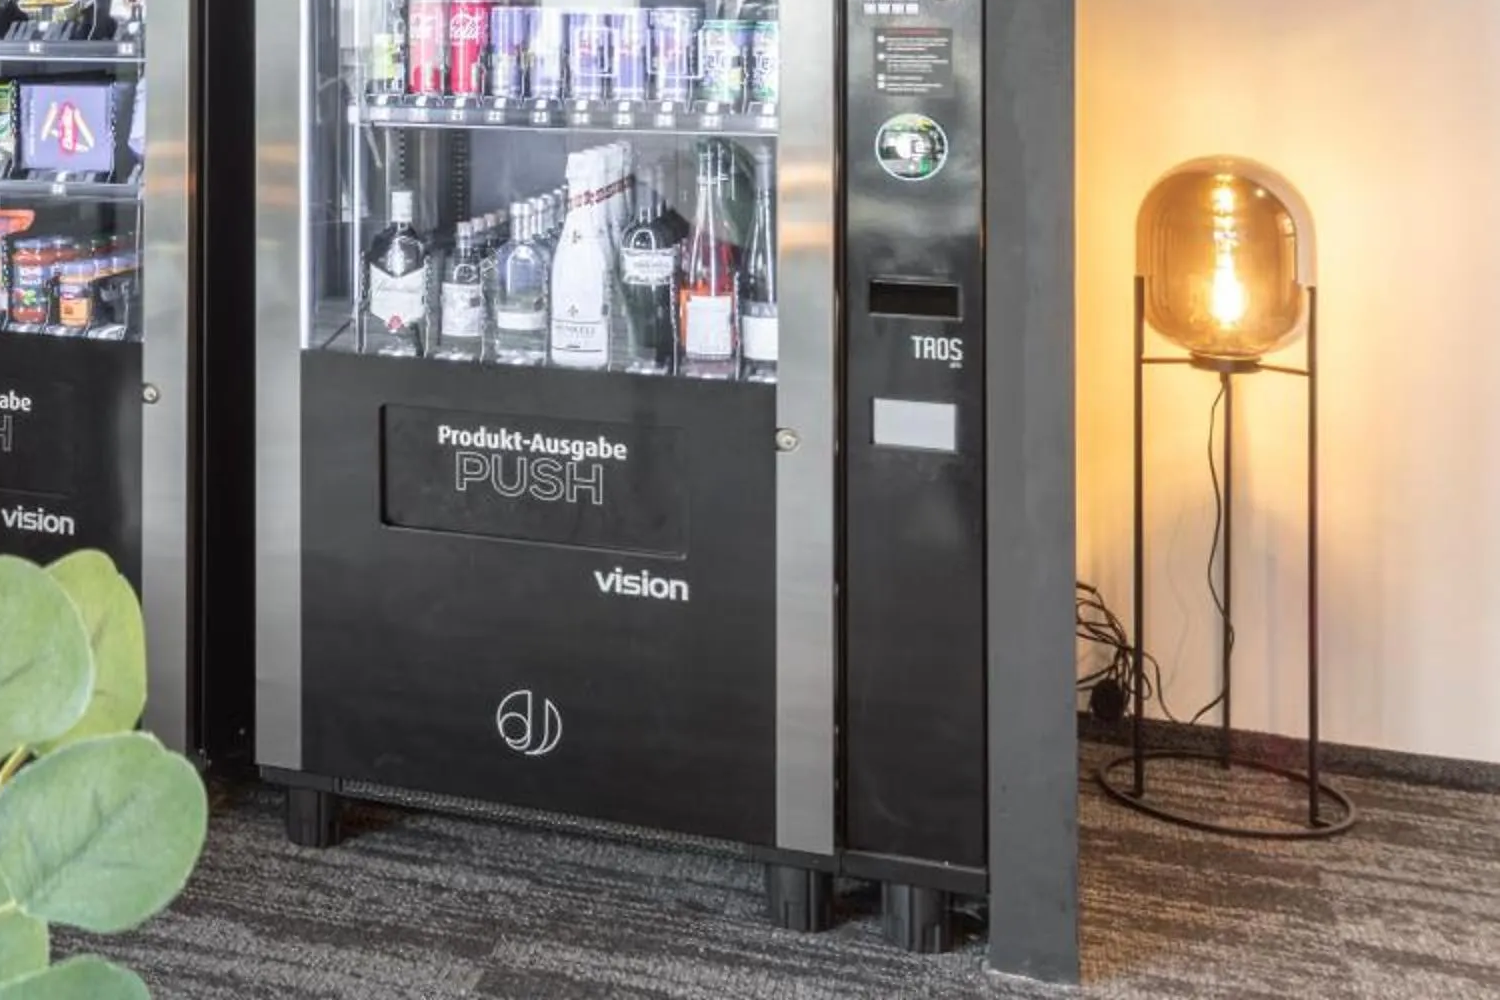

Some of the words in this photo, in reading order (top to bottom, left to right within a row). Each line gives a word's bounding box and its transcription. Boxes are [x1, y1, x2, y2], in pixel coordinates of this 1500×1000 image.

[438, 425, 628, 461] Produkt-Ausgabe
[455, 451, 604, 505] PUSH
[0, 506, 76, 536] vision
[593, 567, 689, 602] vision
